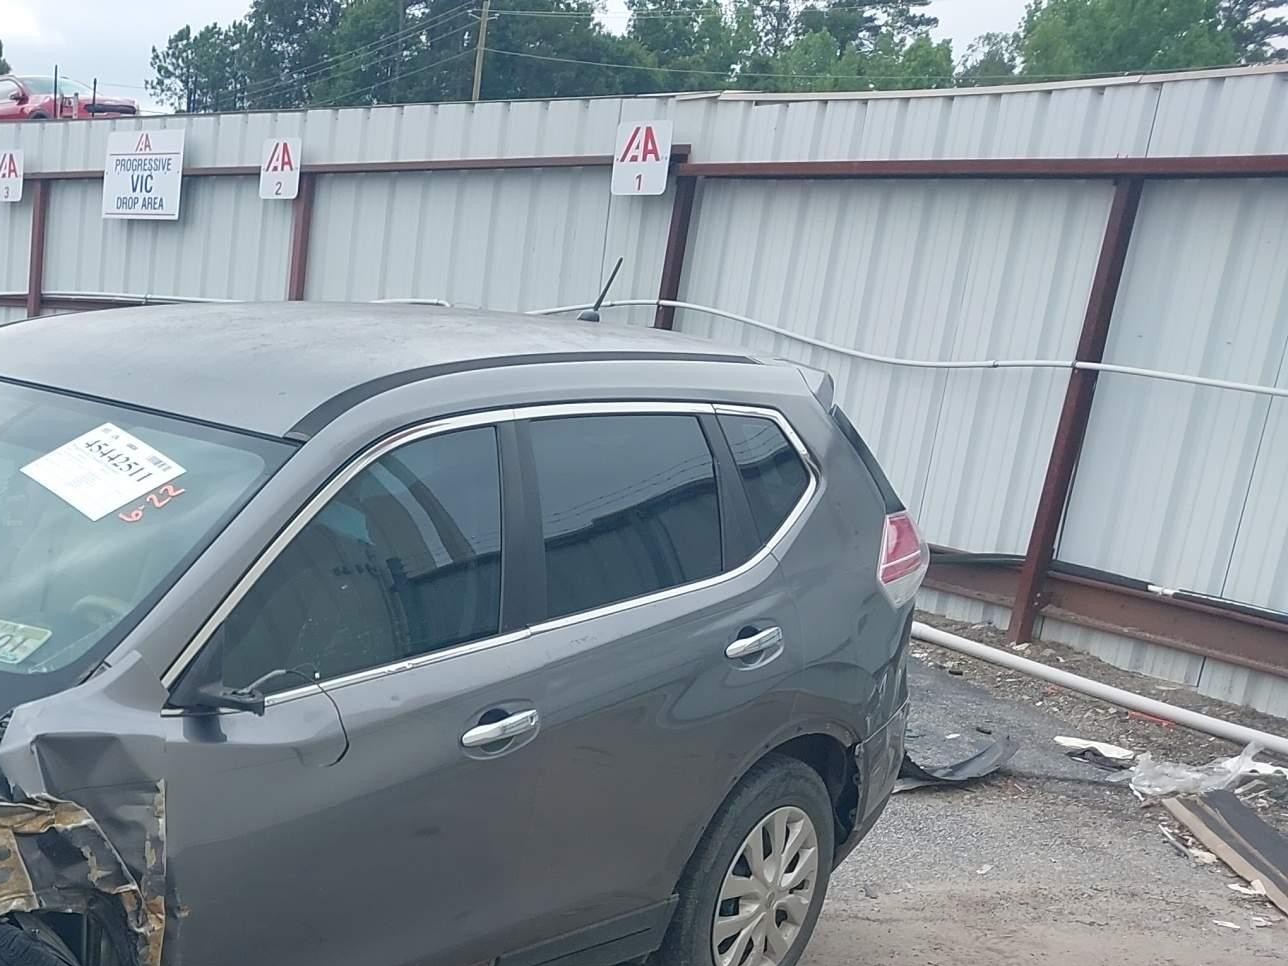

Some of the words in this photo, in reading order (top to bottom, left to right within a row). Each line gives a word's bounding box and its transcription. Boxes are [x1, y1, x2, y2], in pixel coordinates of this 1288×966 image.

[114, 158, 173, 172] PROGRESSIVE
[130, 174, 154, 194] VIC
[274, 181, 283, 196] 2
[635, 173, 643, 192] 1
[3, 186, 10, 199] 3
[115, 196, 140, 210] DROP
[140, 196, 165, 211] AREA
[84, 439, 154, 482] 45442511
